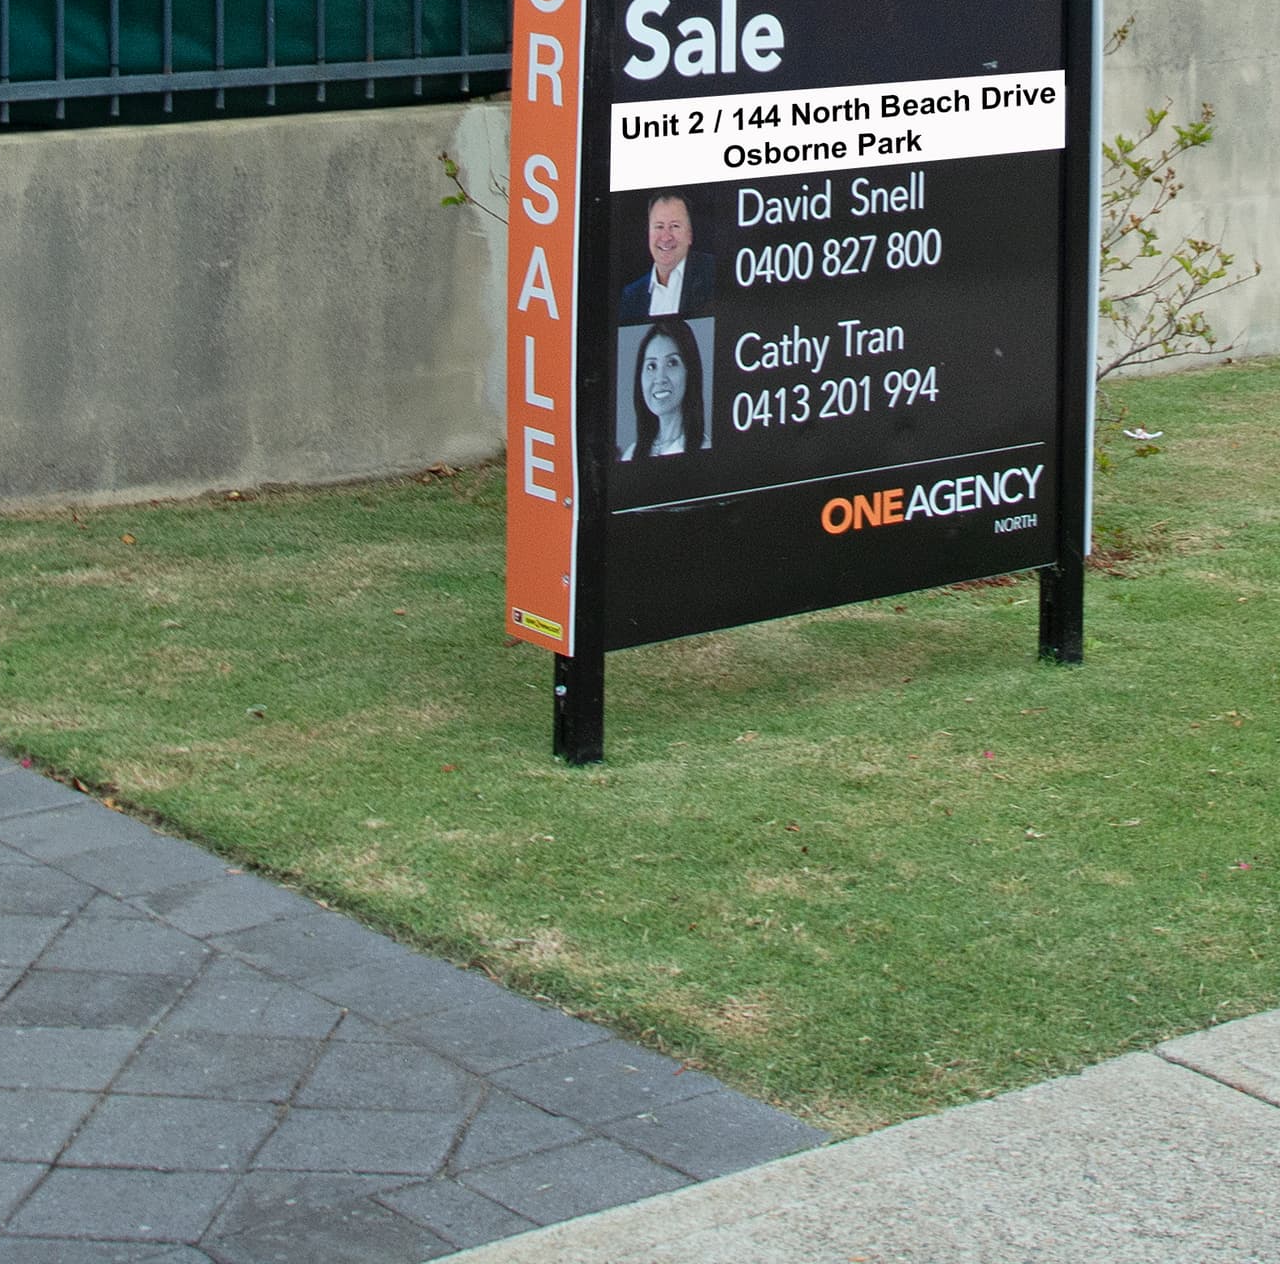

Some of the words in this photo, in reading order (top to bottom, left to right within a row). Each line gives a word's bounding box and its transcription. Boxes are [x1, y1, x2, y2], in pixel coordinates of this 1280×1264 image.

[622, 114, 680, 140] Unit
[688, 111, 704, 135] 2
[732, 104, 782, 131] 144
[791, 97, 870, 126] North
[881, 89, 970, 118] Beach
[982, 82, 1056, 111] Drive
[723, 141, 847, 168] Osborne
[858, 129, 922, 156] Park
[737, 178, 832, 228] David
[850, 170, 925, 217] Snell
[735, 241, 815, 287] 0400
[821, 234, 878, 278] 827
[886, 227, 943, 270] 800
[518, 154, 559, 501] SALE
[734, 324, 831, 374] Cathy
[836, 319, 905, 358] Tran
[732, 383, 811, 432] 0413
[818, 375, 871, 419] 201
[883, 365, 940, 409] 994
[995, 514, 1038, 534] NORTH
